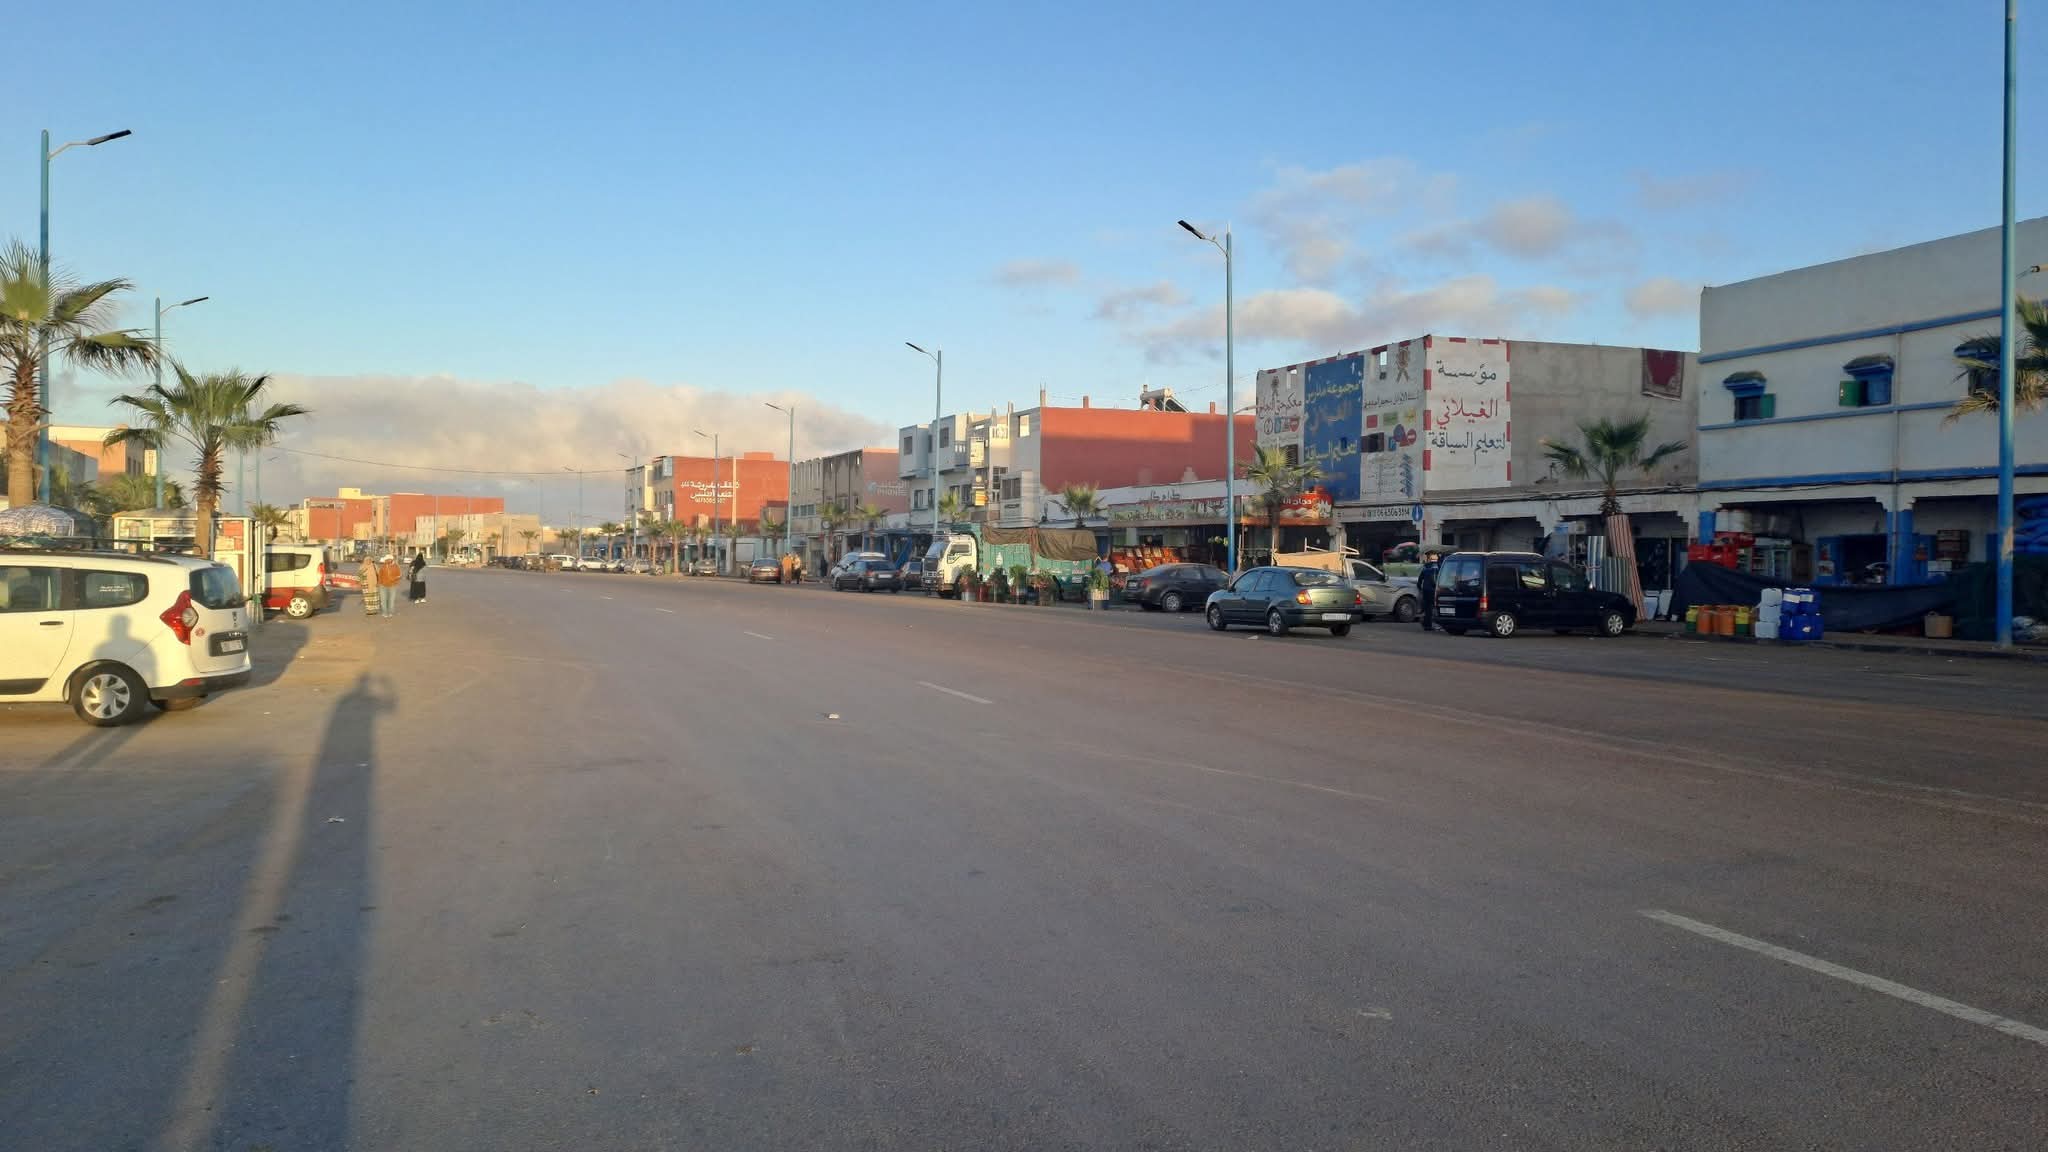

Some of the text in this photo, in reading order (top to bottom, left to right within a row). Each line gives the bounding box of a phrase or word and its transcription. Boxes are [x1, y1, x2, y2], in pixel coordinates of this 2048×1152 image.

[1436, 360, 1497, 385] مؤسسة
[1437, 397, 1498, 430] الغيلاني
[1428, 431, 1506, 464] لتعليم السياقة
